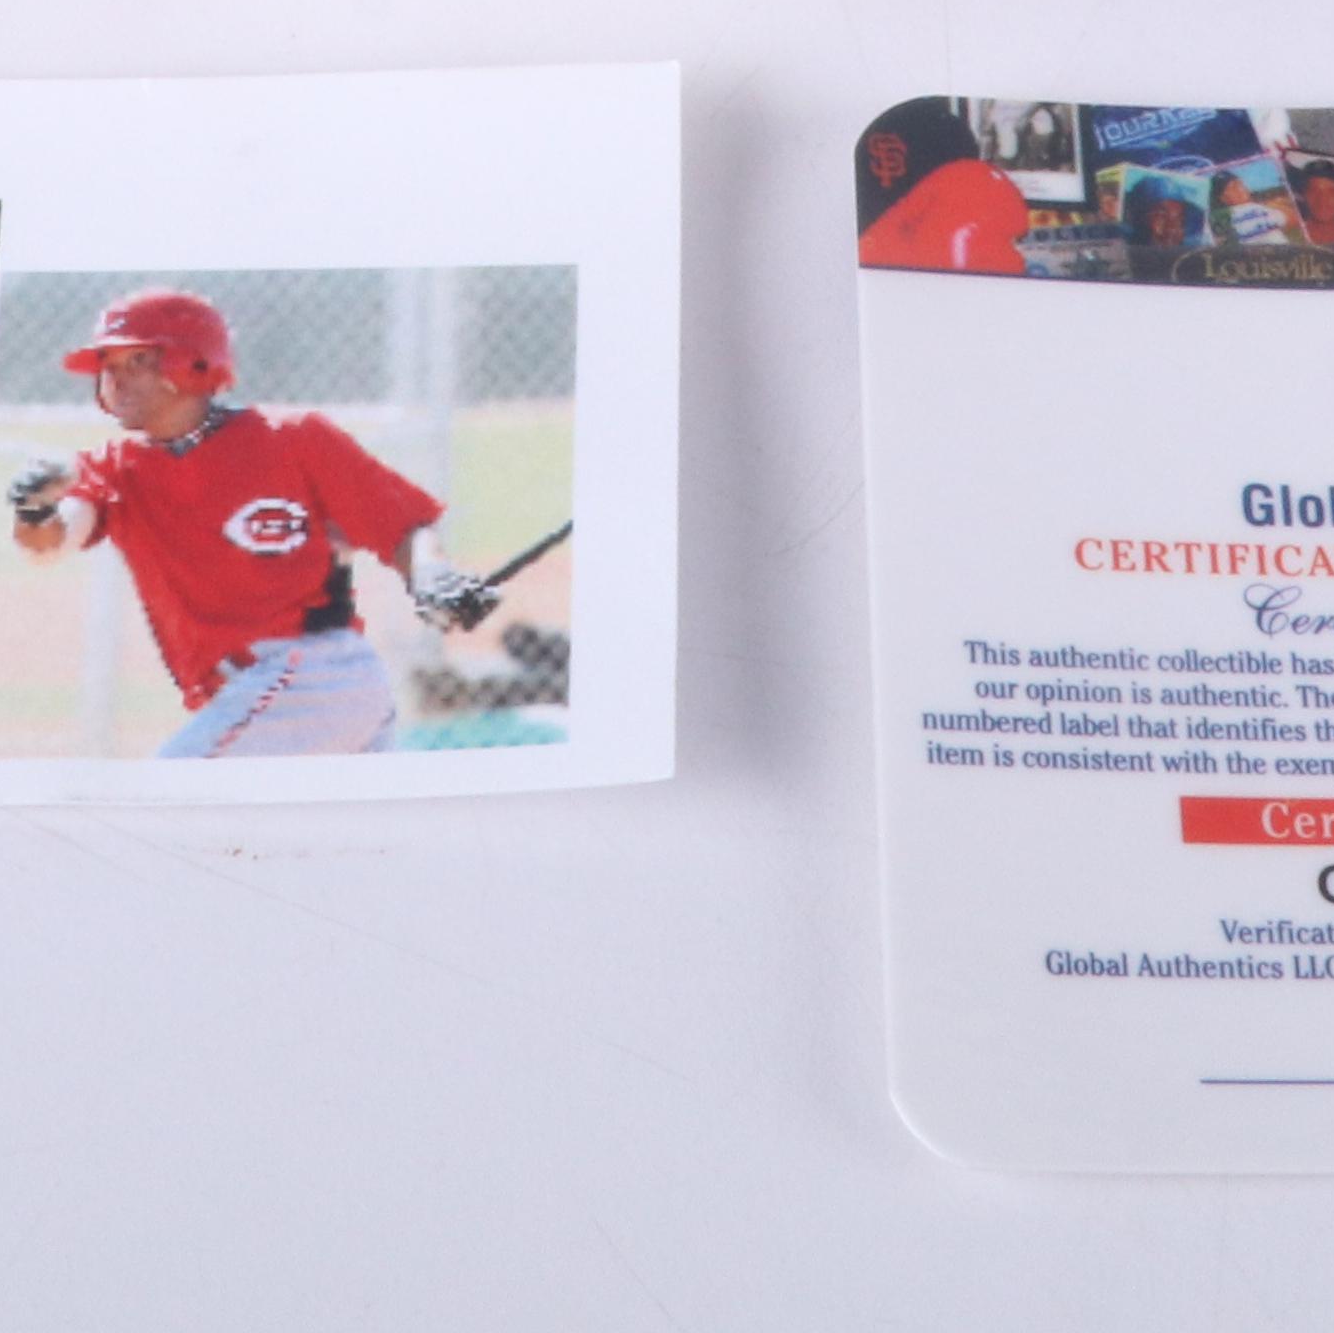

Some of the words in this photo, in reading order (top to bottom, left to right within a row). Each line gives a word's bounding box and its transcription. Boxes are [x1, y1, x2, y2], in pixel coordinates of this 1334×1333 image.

[1201, 252, 1333, 283] Louisville
[965, 640, 1020, 666] This
[1029, 645, 1149, 671] authentic
[1158, 650, 1281, 675] collectible
[1292, 654, 1334, 675] has
[976, 680, 1018, 701] our
[1026, 679, 1123, 706] opinion
[1133, 683, 1152, 704] is
[1161, 684, 1289, 708] authentic.
[923, 710, 1051, 734] numbered
[1060, 714, 1119, 736] label
[1128, 719, 1177, 739] that
[1186, 718, 1306, 742] identifies
[927, 741, 984, 766] item
[994, 744, 1014, 767] is
[1023, 747, 1155, 772] consistent
[1163, 751, 1217, 774] with
[1226, 752, 1265, 774] the
[1045, 951, 1129, 977] Global
[1138, 953, 1284, 980] Authentics
